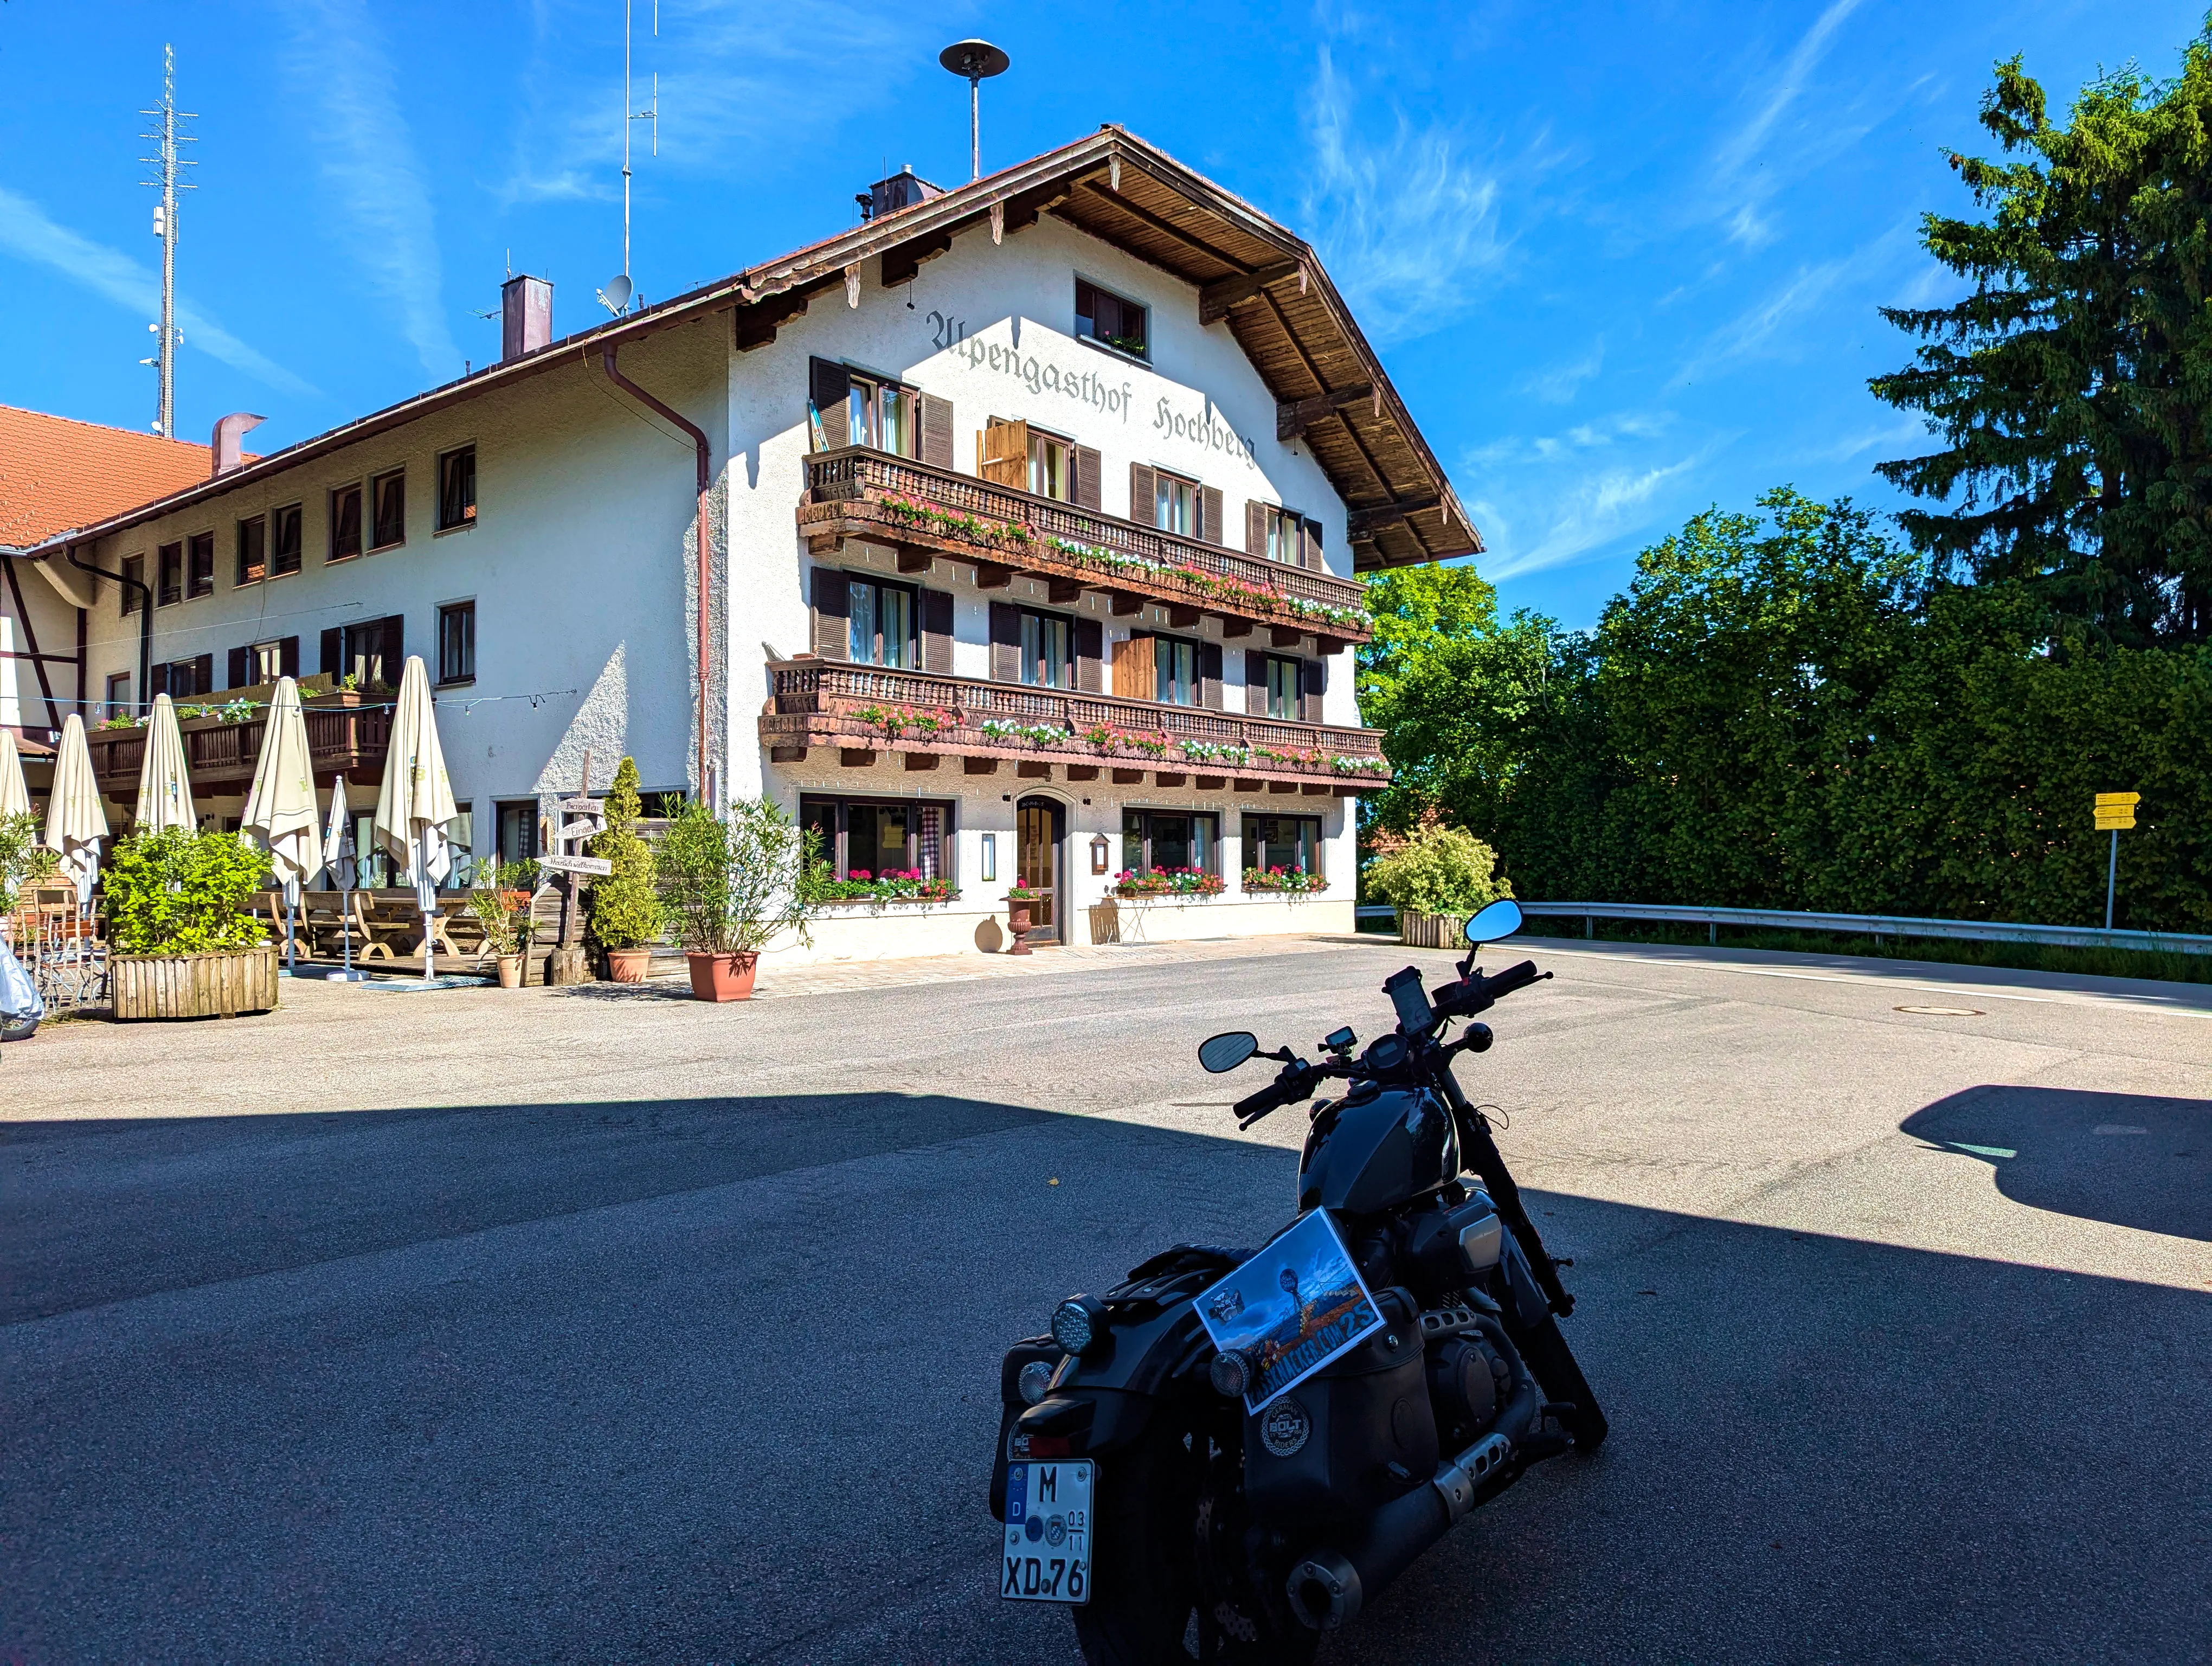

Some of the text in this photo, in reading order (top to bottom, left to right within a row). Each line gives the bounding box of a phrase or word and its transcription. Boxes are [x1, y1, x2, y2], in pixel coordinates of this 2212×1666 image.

[926, 310, 1256, 470] Alpengasthof Hochberg
[565, 802, 599, 811] Biergarten
[573, 861, 607, 871] willkommen
[1271, 1404, 1298, 1418] GERMAN
[1269, 1419, 1302, 1432] BOLT
[1274, 1437, 1297, 1449] RIDERS
[1039, 1466, 1057, 1502] M
[1012, 1502, 1020, 1516] D
[1069, 1511, 1084, 1526] 03
[1069, 1535, 1083, 1551] 11
[1004, 1556, 1084, 1597] XD 76
